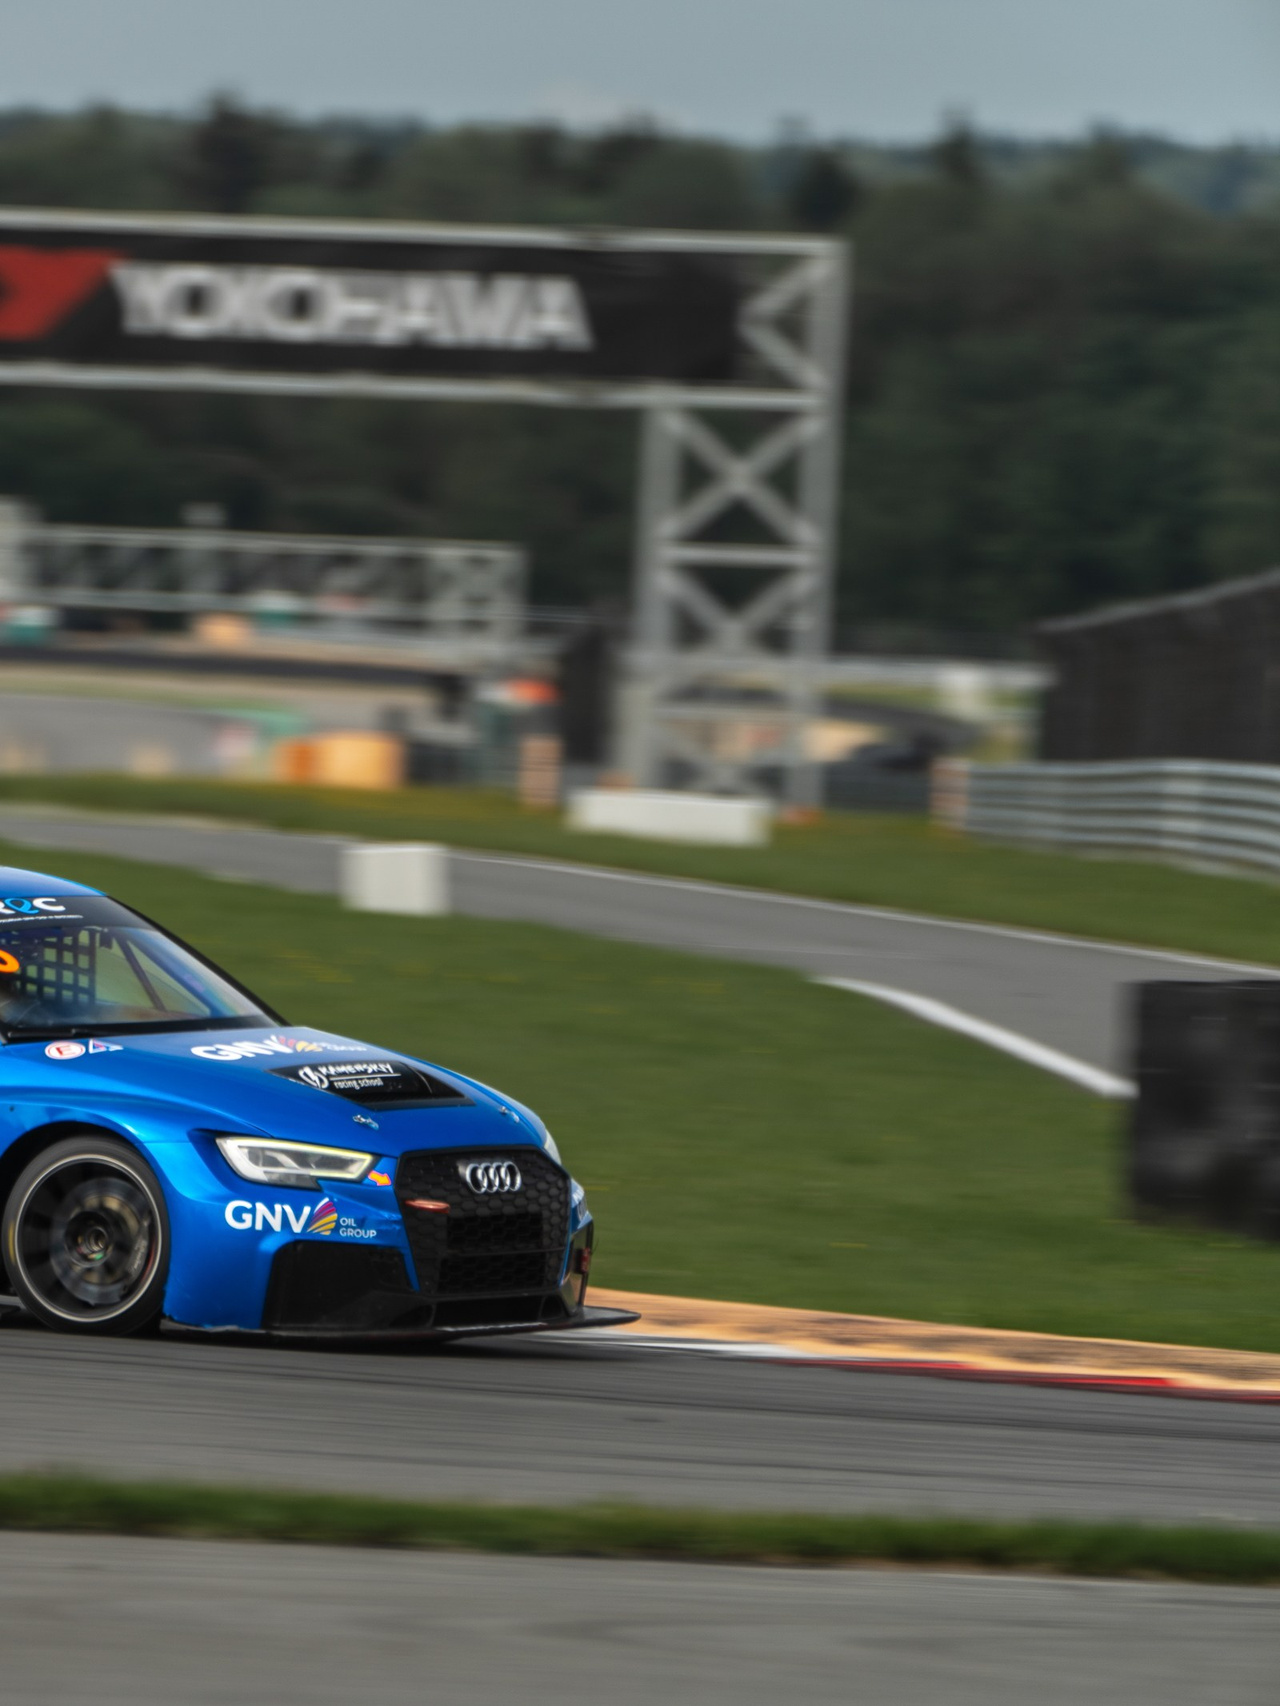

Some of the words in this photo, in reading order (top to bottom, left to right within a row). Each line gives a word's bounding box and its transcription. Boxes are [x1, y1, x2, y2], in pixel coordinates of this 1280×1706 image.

[109, 258, 594, 351] YOKOHAMA
[190, 1035, 295, 1061] GNV
[333, 1080, 359, 1090] racing
[358, 1077, 384, 1088] school
[224, 1200, 311, 1233] GNV
[339, 1216, 357, 1227] OIL
[339, 1228, 377, 1239] GROUP
